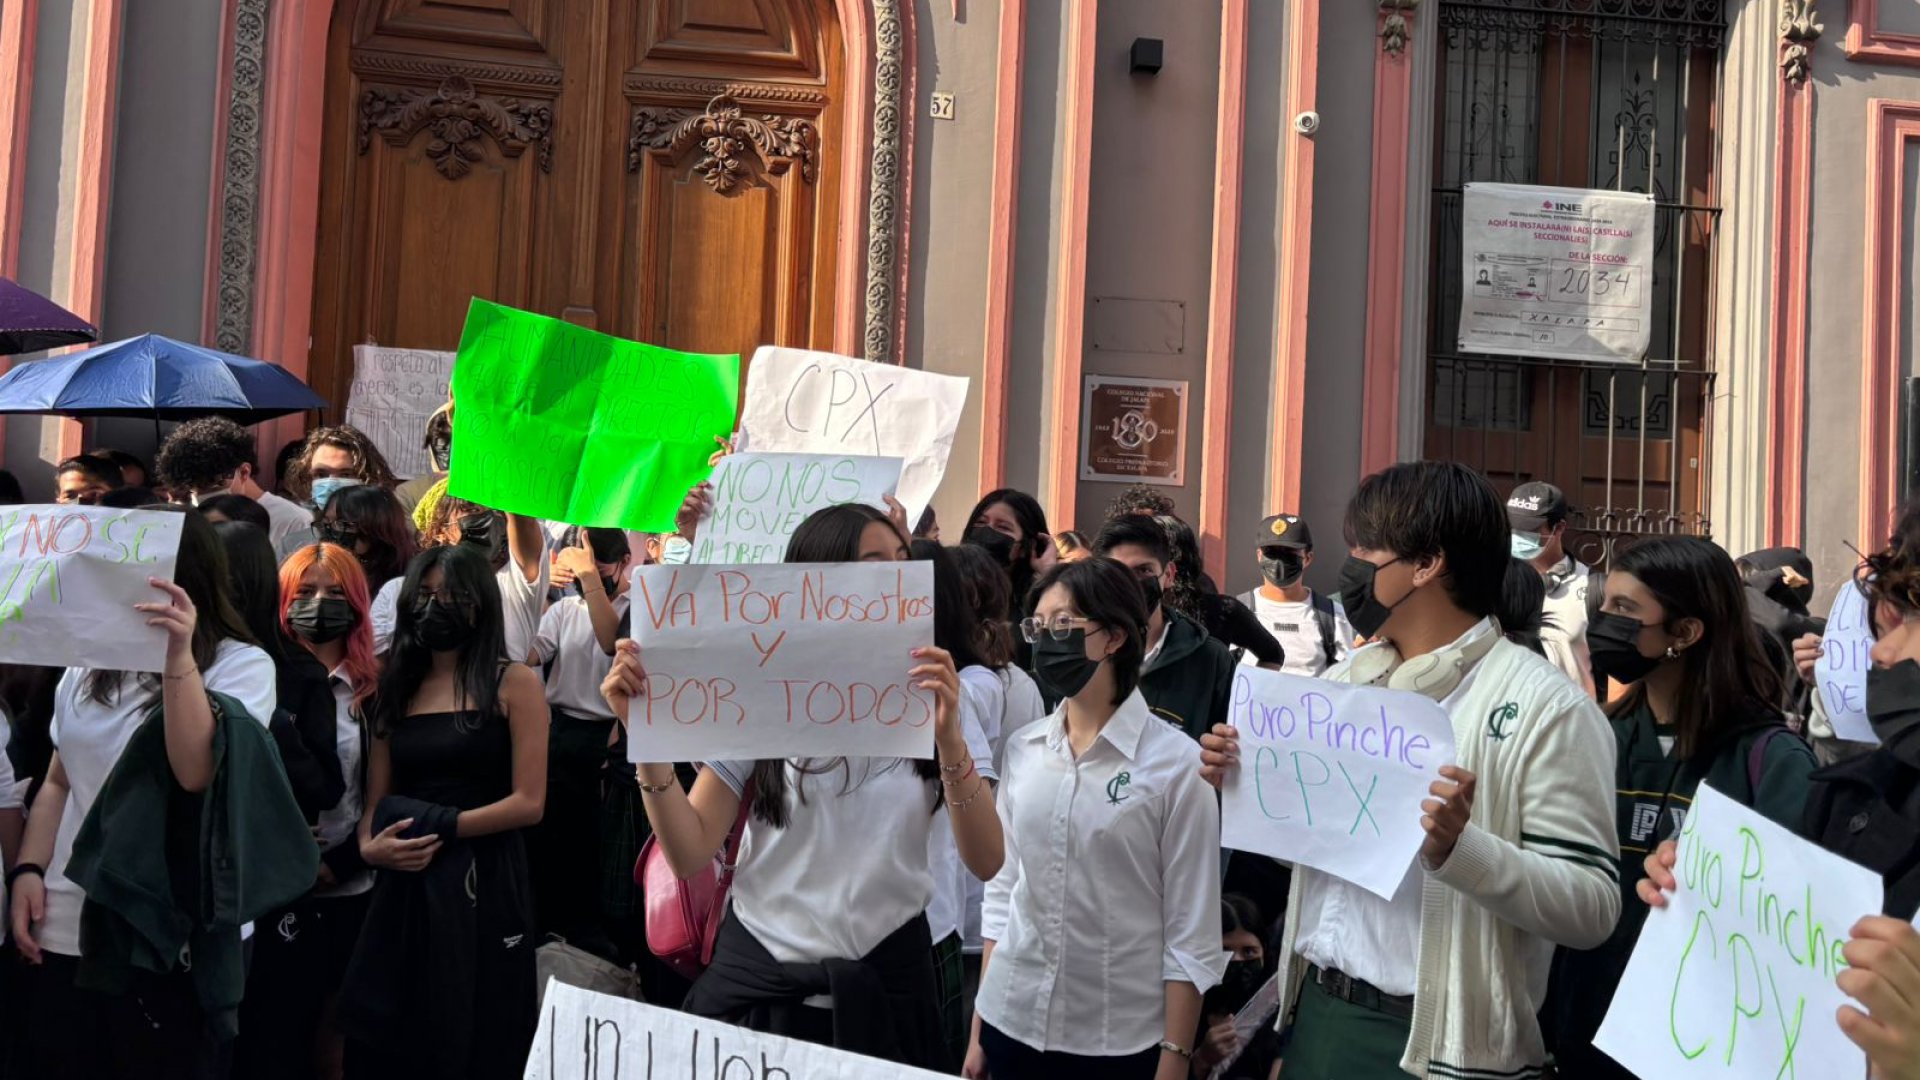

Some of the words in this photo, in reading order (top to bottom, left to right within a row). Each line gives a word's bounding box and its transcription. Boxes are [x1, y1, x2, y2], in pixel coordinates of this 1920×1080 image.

[932, 97, 952, 115] 57
[1555, 203, 1583, 212] INE
[1581, 252, 1591, 260] LA
[1558, 267, 1631, 297] 2034
[374, 351, 423, 373] respeto
[428, 353, 442, 374] al
[783, 363, 894, 456] CPX
[716, 459, 773, 503] NO
[776, 459, 861, 508] NOS
[19, 513, 93, 558] NO
[801, 568, 934, 625] Nosotros
[751, 630, 786, 668] Y
[646, 672, 745, 726] POR
[765, 679, 931, 728] TODOS
[1232, 673, 1296, 741] Puro
[1300, 691, 1431, 770] Pinche
[1254, 746, 1381, 838] CPX
[1671, 909, 1805, 1080] CPX
